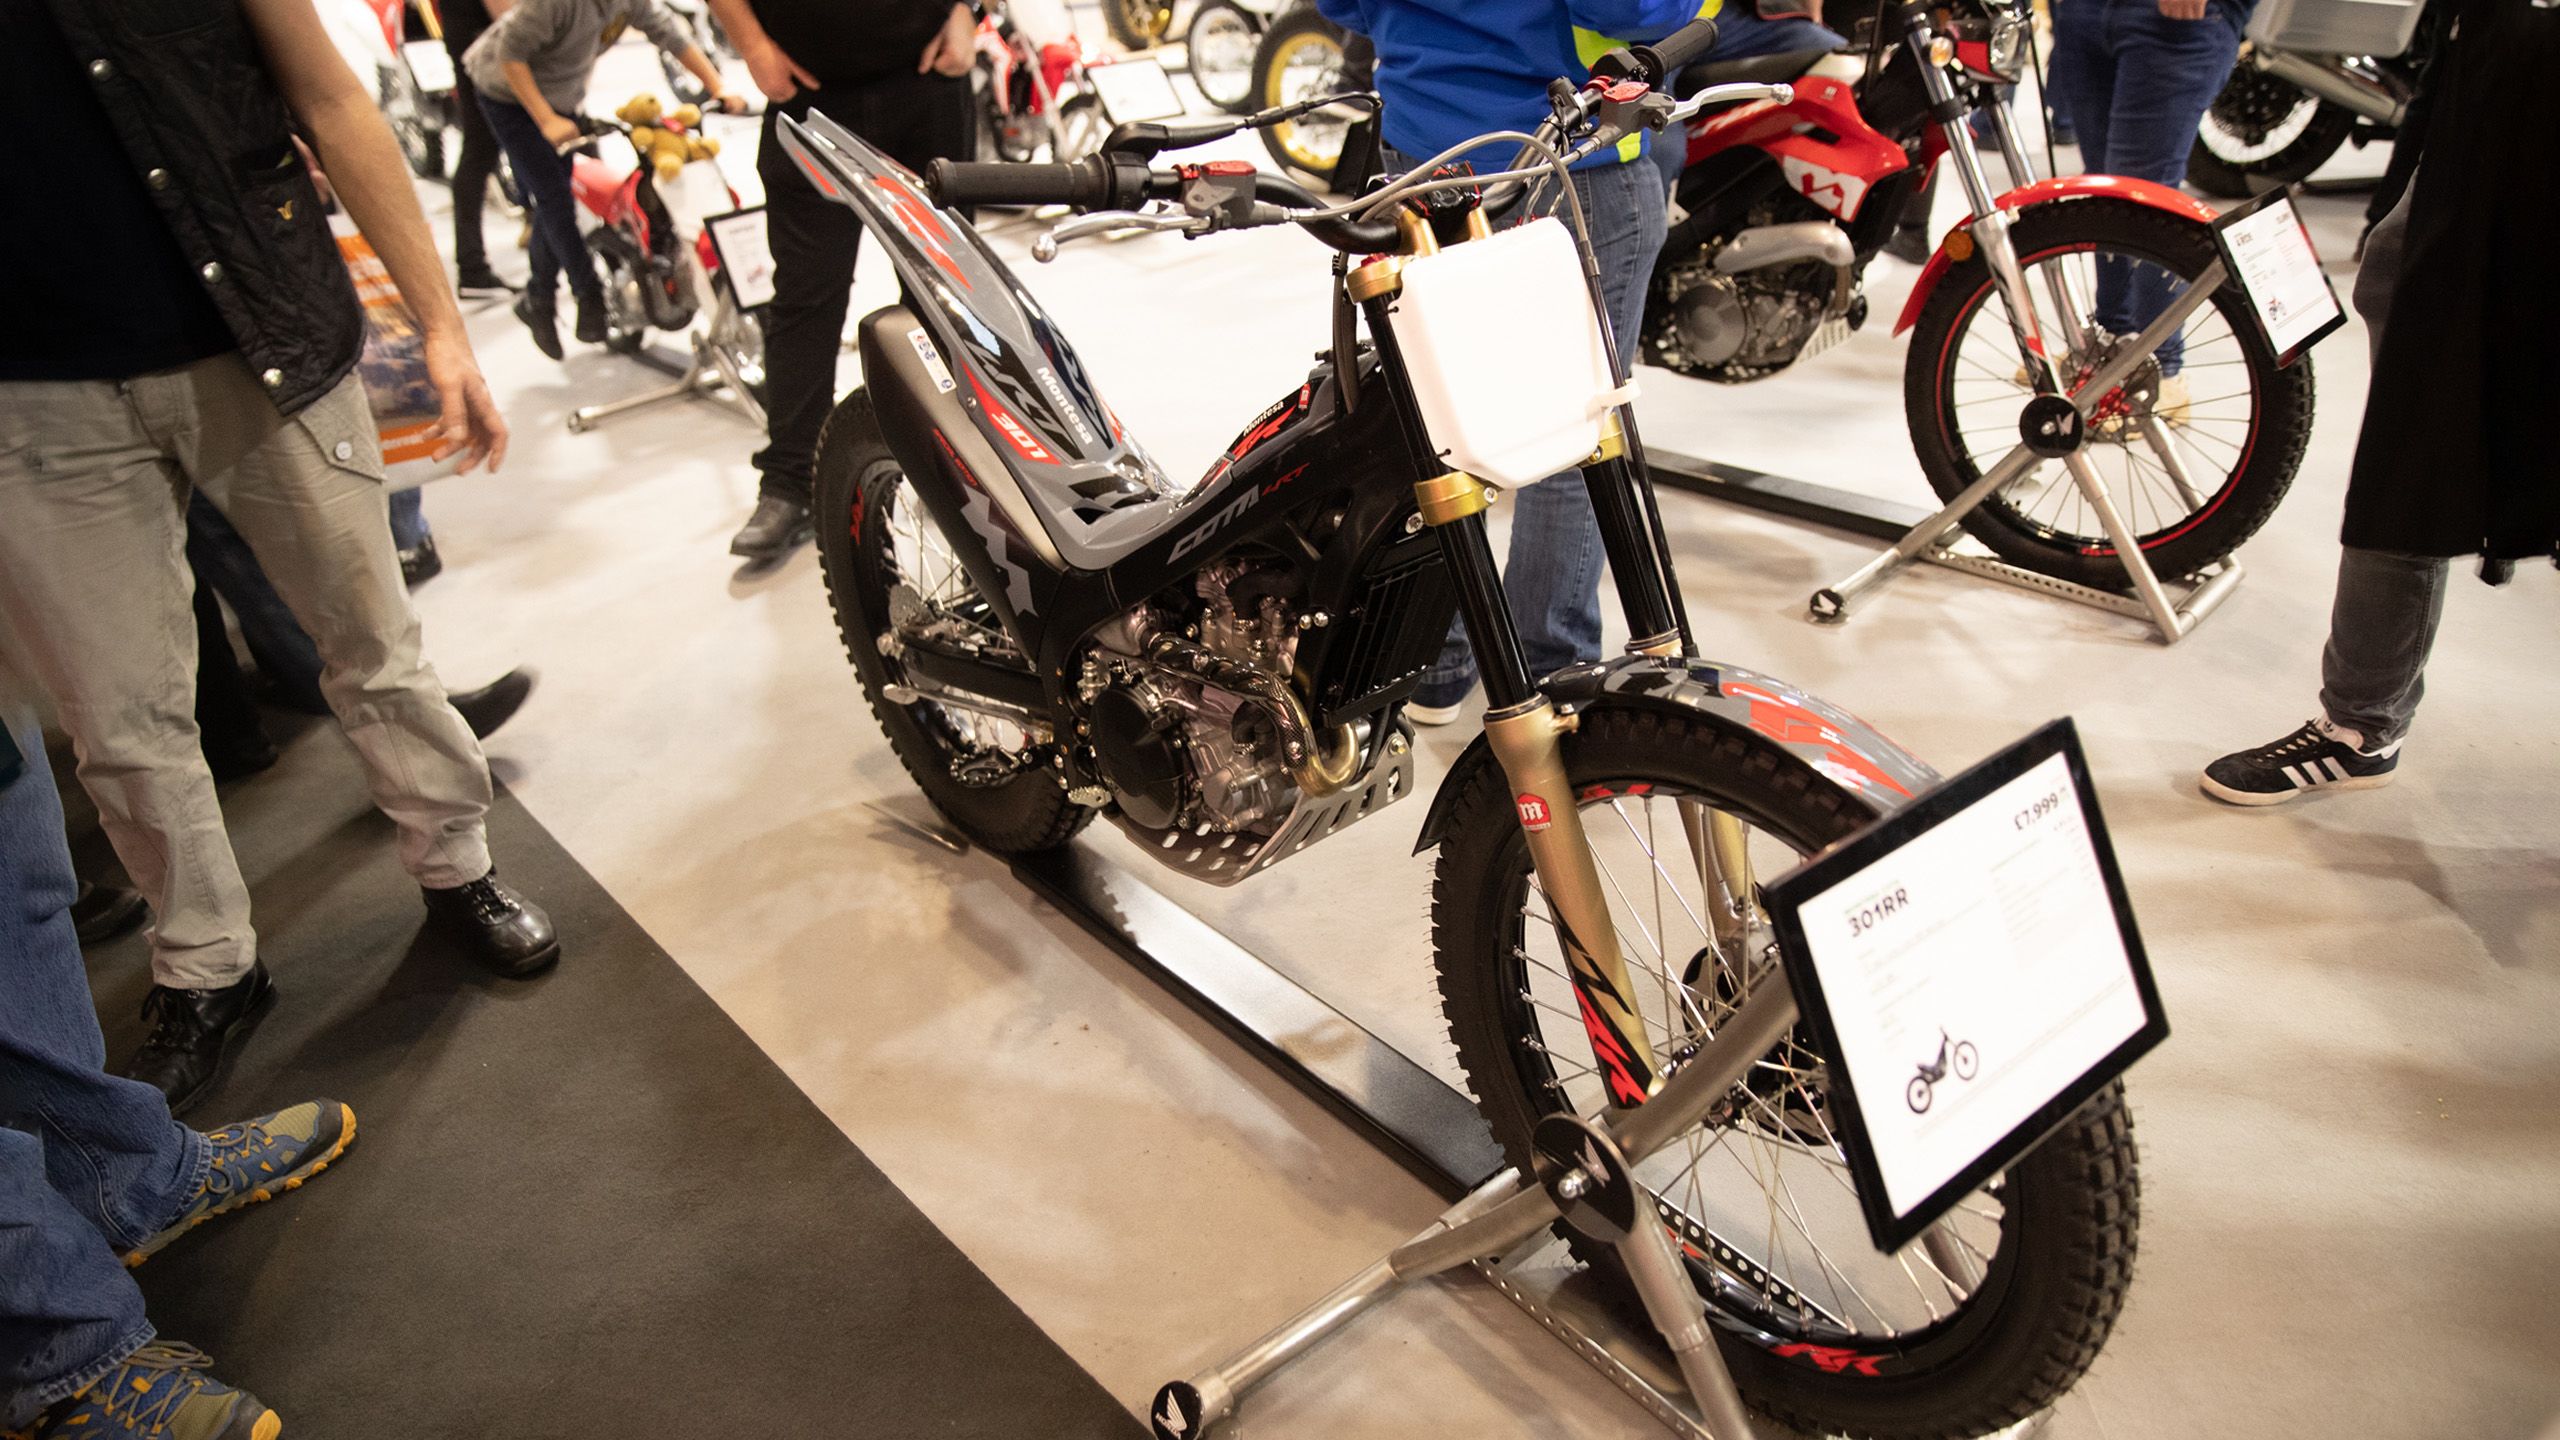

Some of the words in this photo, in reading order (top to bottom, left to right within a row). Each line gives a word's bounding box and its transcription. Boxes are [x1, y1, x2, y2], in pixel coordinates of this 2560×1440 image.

[1037, 366, 1094, 446] Montesa
[1243, 400, 1285, 437] Montesa
[991, 411, 1050, 459] 301
[1848, 887, 1909, 938] 301RR
